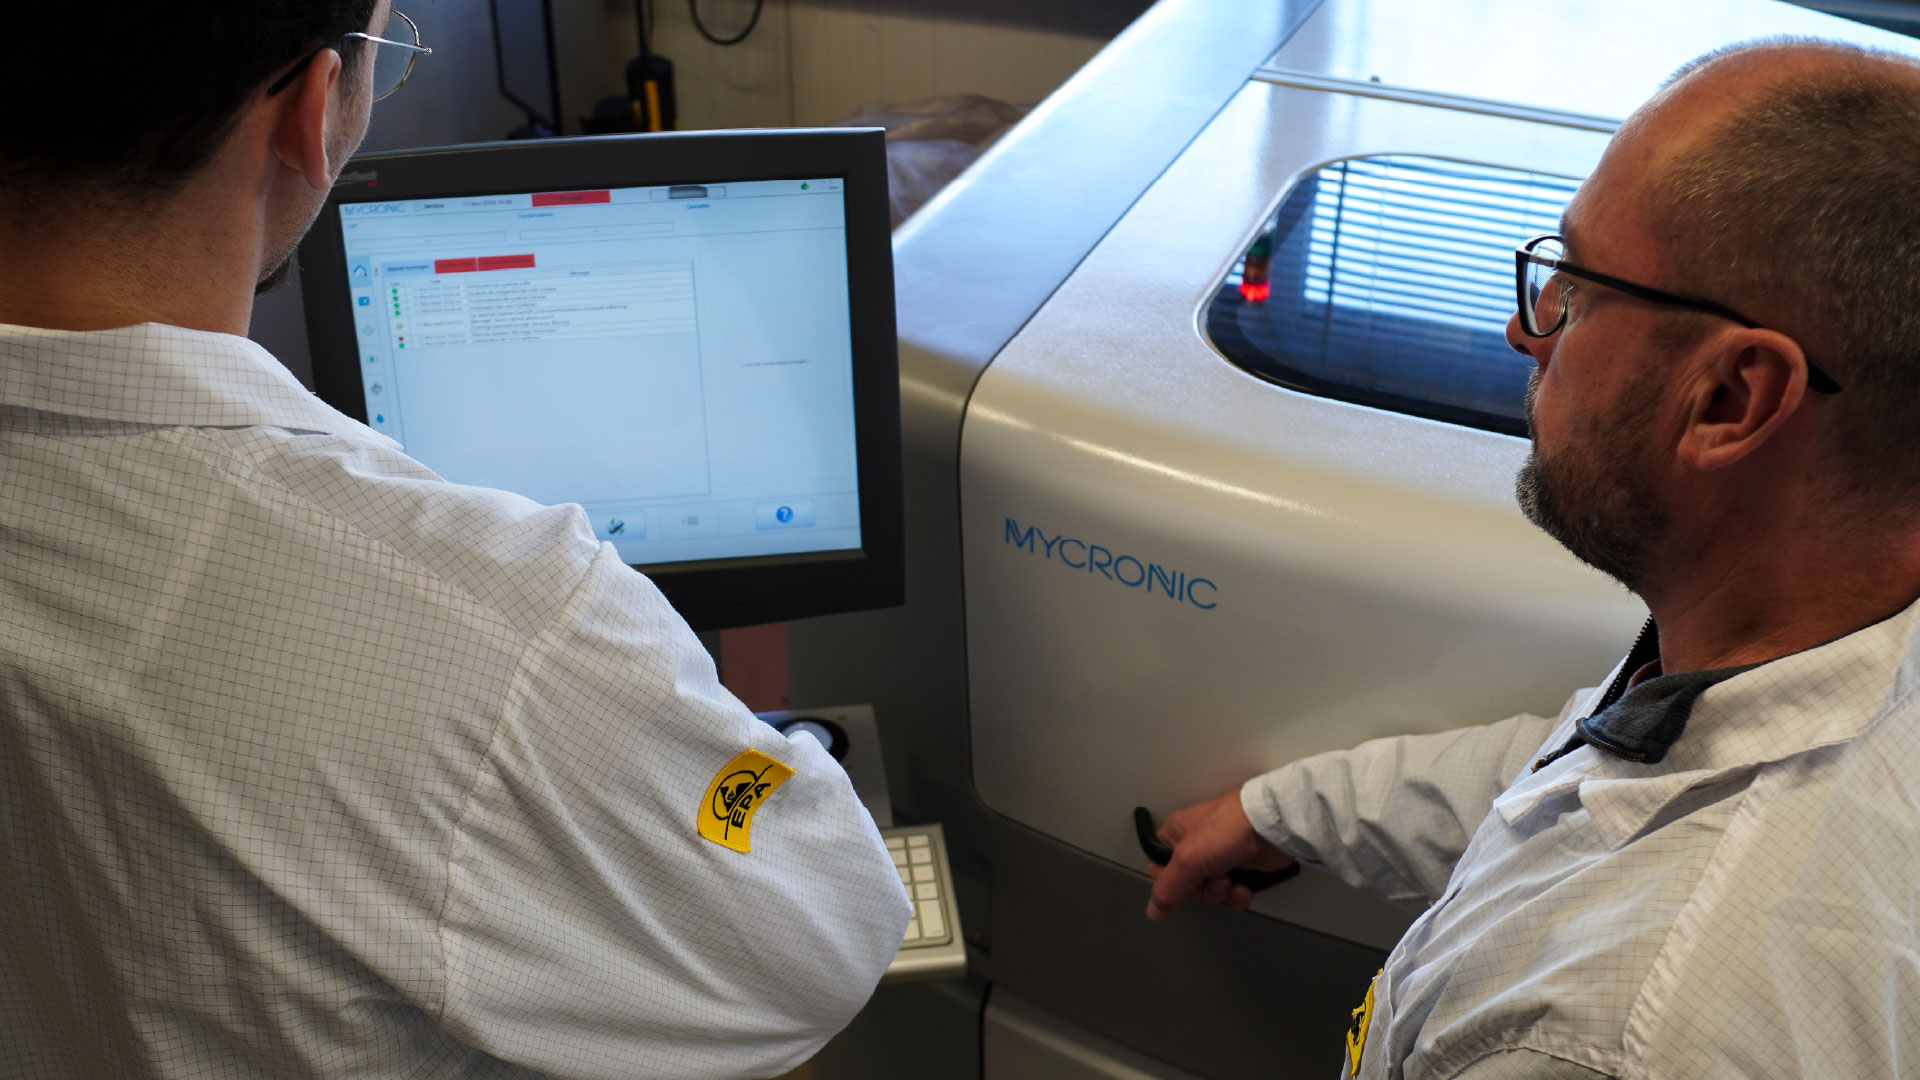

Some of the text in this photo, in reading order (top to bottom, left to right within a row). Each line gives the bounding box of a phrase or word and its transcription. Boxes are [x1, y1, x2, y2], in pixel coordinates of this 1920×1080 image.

[344, 202, 406, 215] MYCRONIC
[1005, 517, 1218, 610] MYCRONIC
[730, 782, 772, 829] EPA
